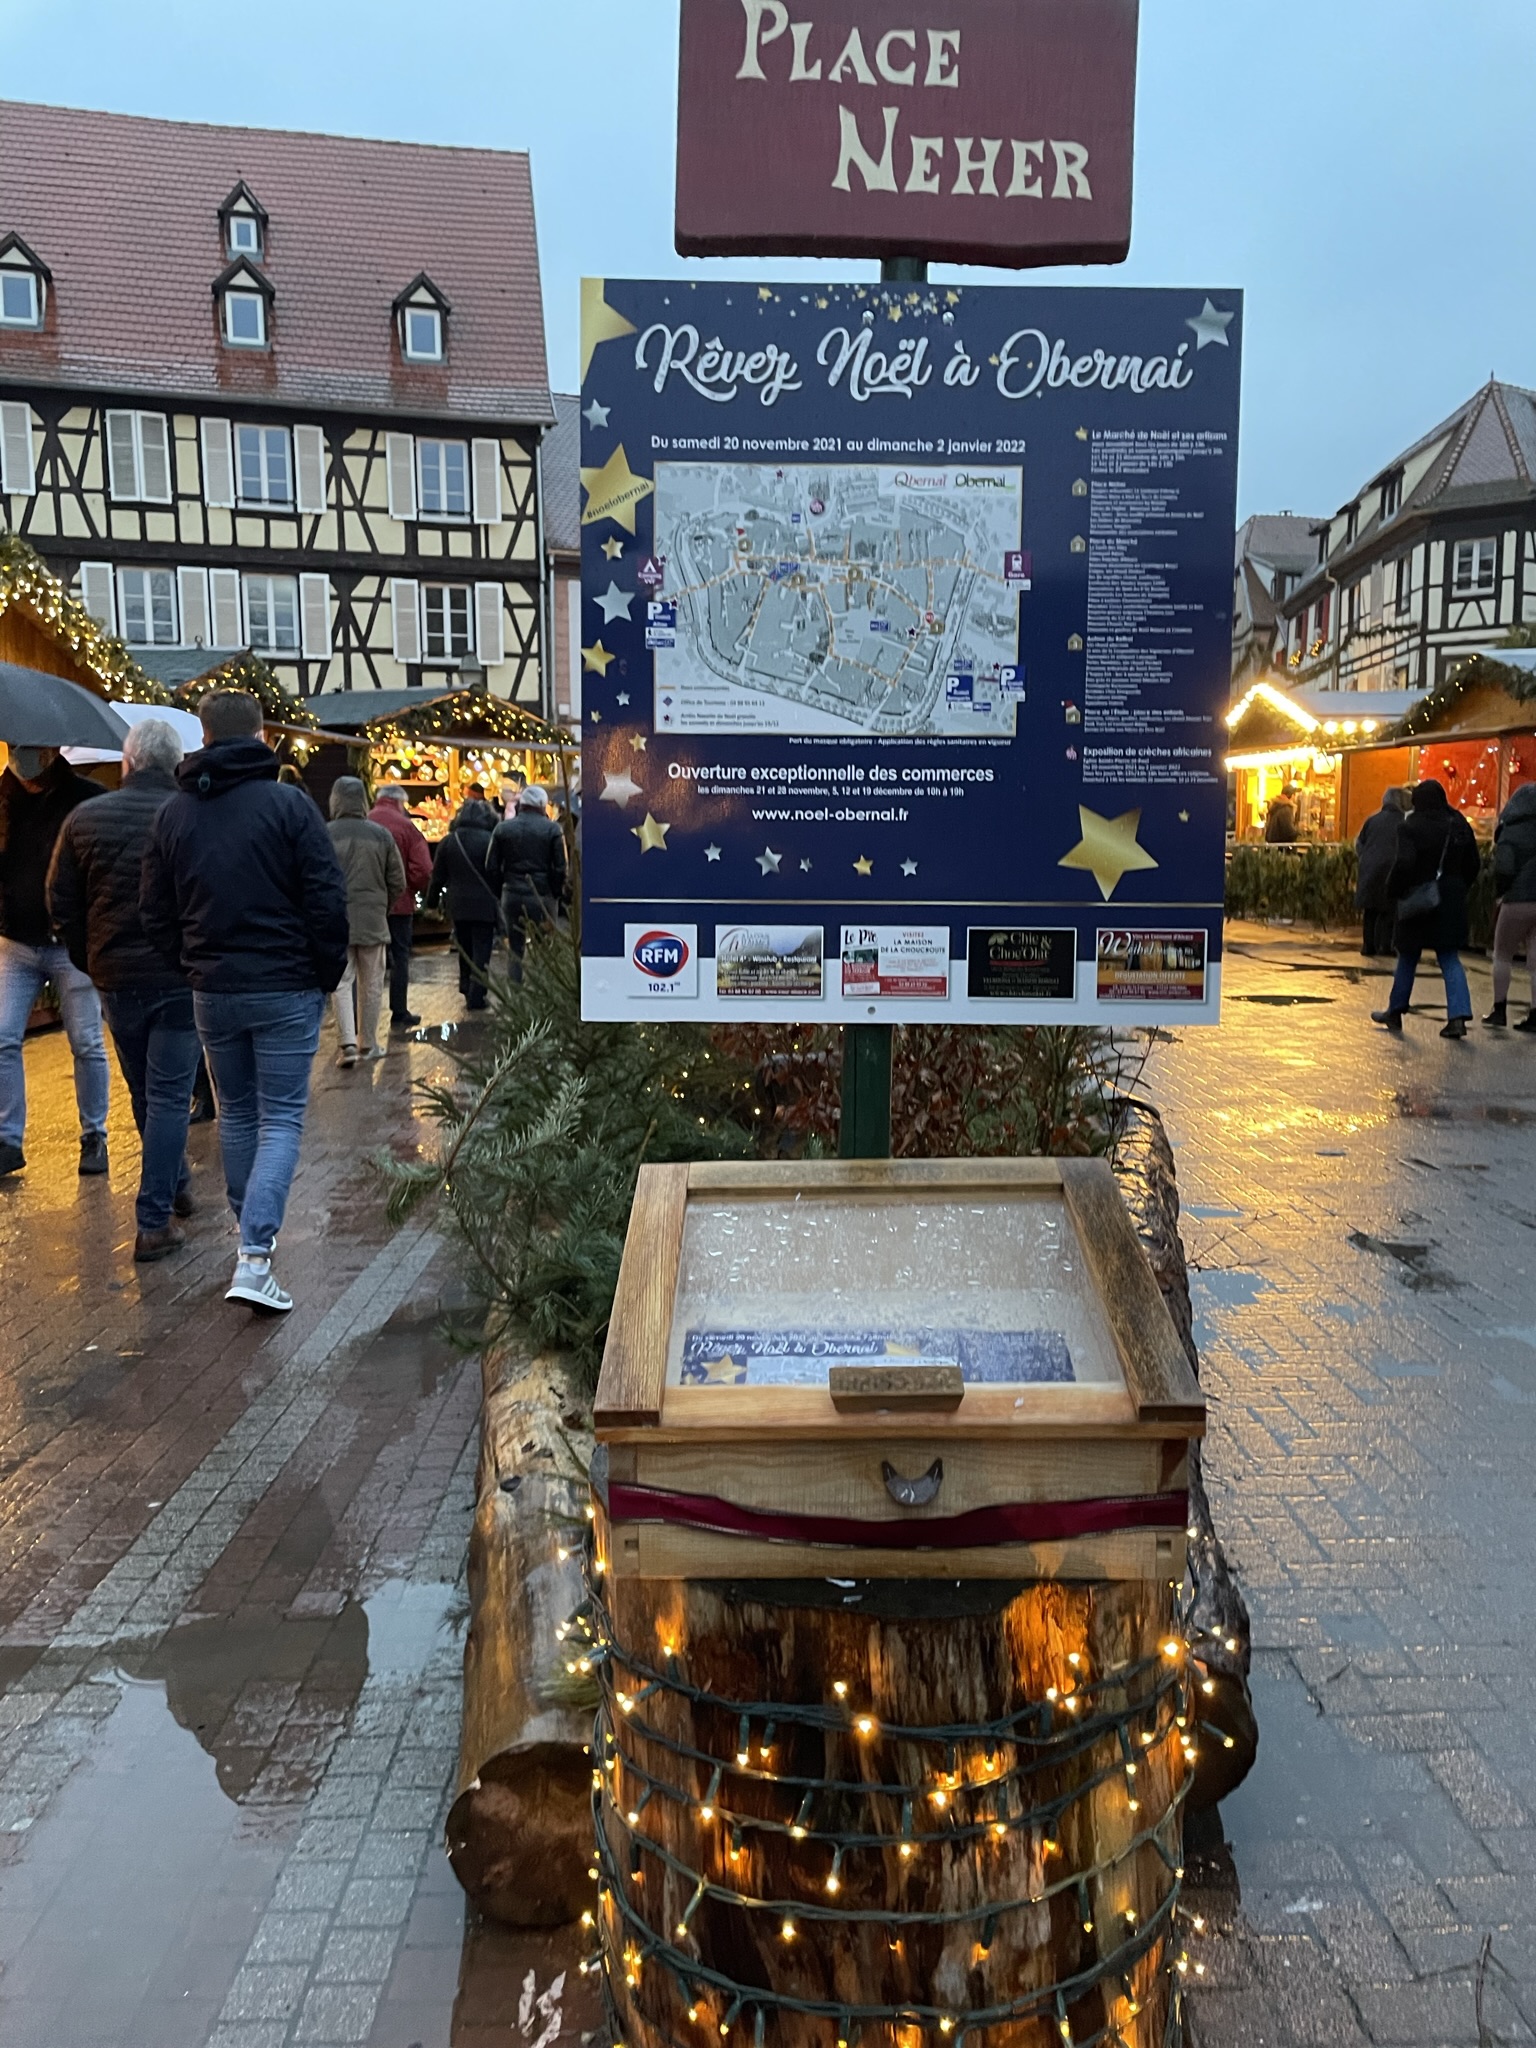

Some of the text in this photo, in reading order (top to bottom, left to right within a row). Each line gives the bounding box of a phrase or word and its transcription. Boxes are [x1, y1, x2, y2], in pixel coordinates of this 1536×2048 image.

[735, 0, 961, 88] PLACE
[831, 104, 1093, 201] NEHER
[635, 323, 1193, 406] Rêvez Noël à Obernai
[651, 435, 1026, 455] Du samedi 20 novembre 2021 au dimanche 2 janvier 2022
[586, 481, 650, 519] #noelobernai
[668, 762, 994, 784] Ouverture exceptionnelle des commerces
[697, 785, 710, 794] les
[711, 785, 755, 795] dimanches
[756, 786, 766, 795] 21
[767, 786, 776, 795] et
[788, 786, 830, 797] novembre,
[852, 787, 861, 796] et
[873, 786, 914, 796] décembre
[914, 786, 925, 796] de
[752, 807, 909, 823] www.noel-obernai.fr
[641, 948, 679, 964] RFM
[648, 983, 675, 993] 102.1
